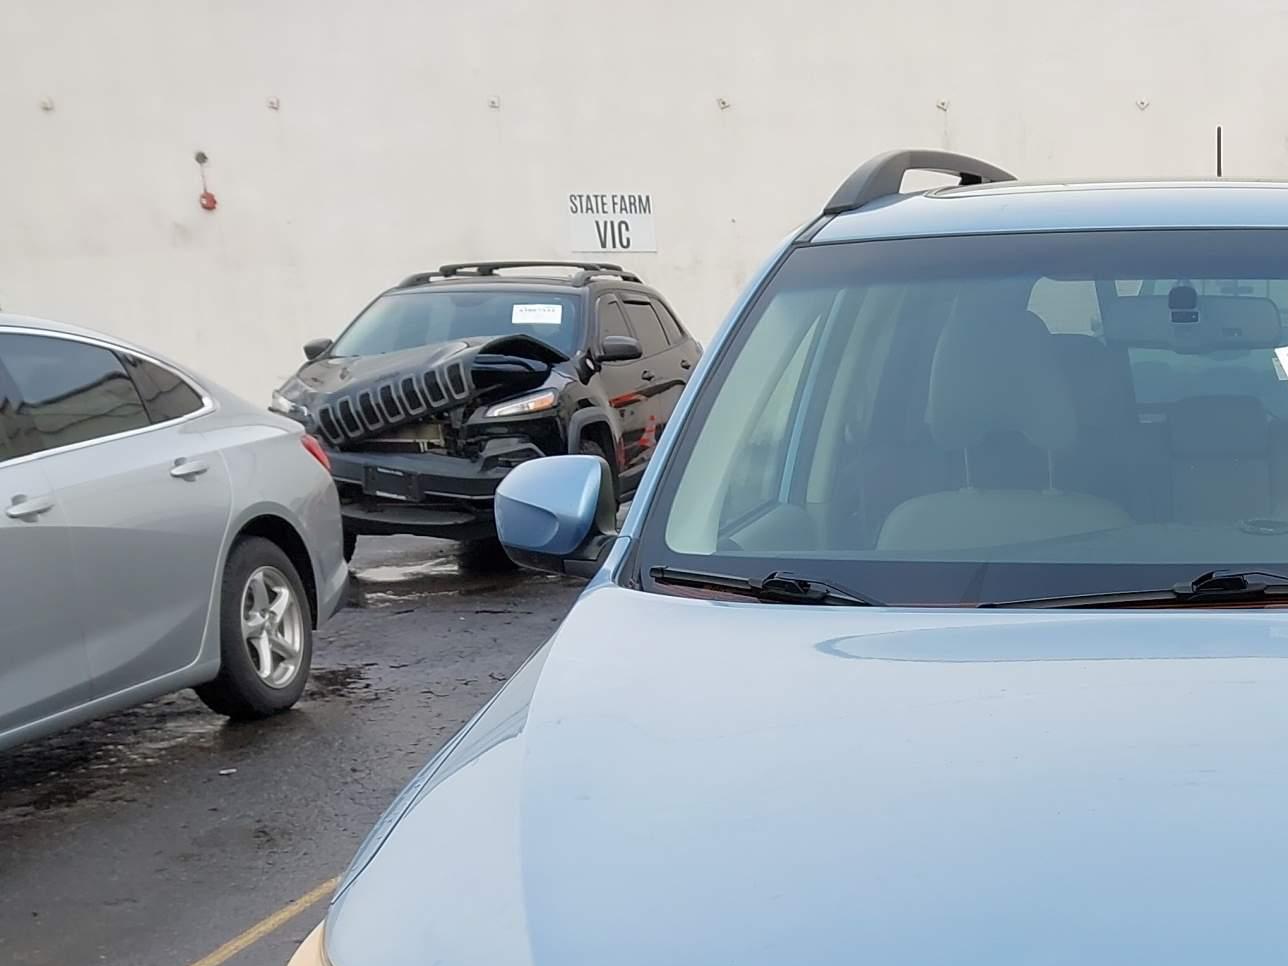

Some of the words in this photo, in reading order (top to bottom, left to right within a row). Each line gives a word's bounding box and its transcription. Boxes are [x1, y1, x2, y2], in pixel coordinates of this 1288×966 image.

[569, 194, 608, 214] STATE
[611, 194, 652, 215] FARM
[595, 219, 631, 249] VIC
